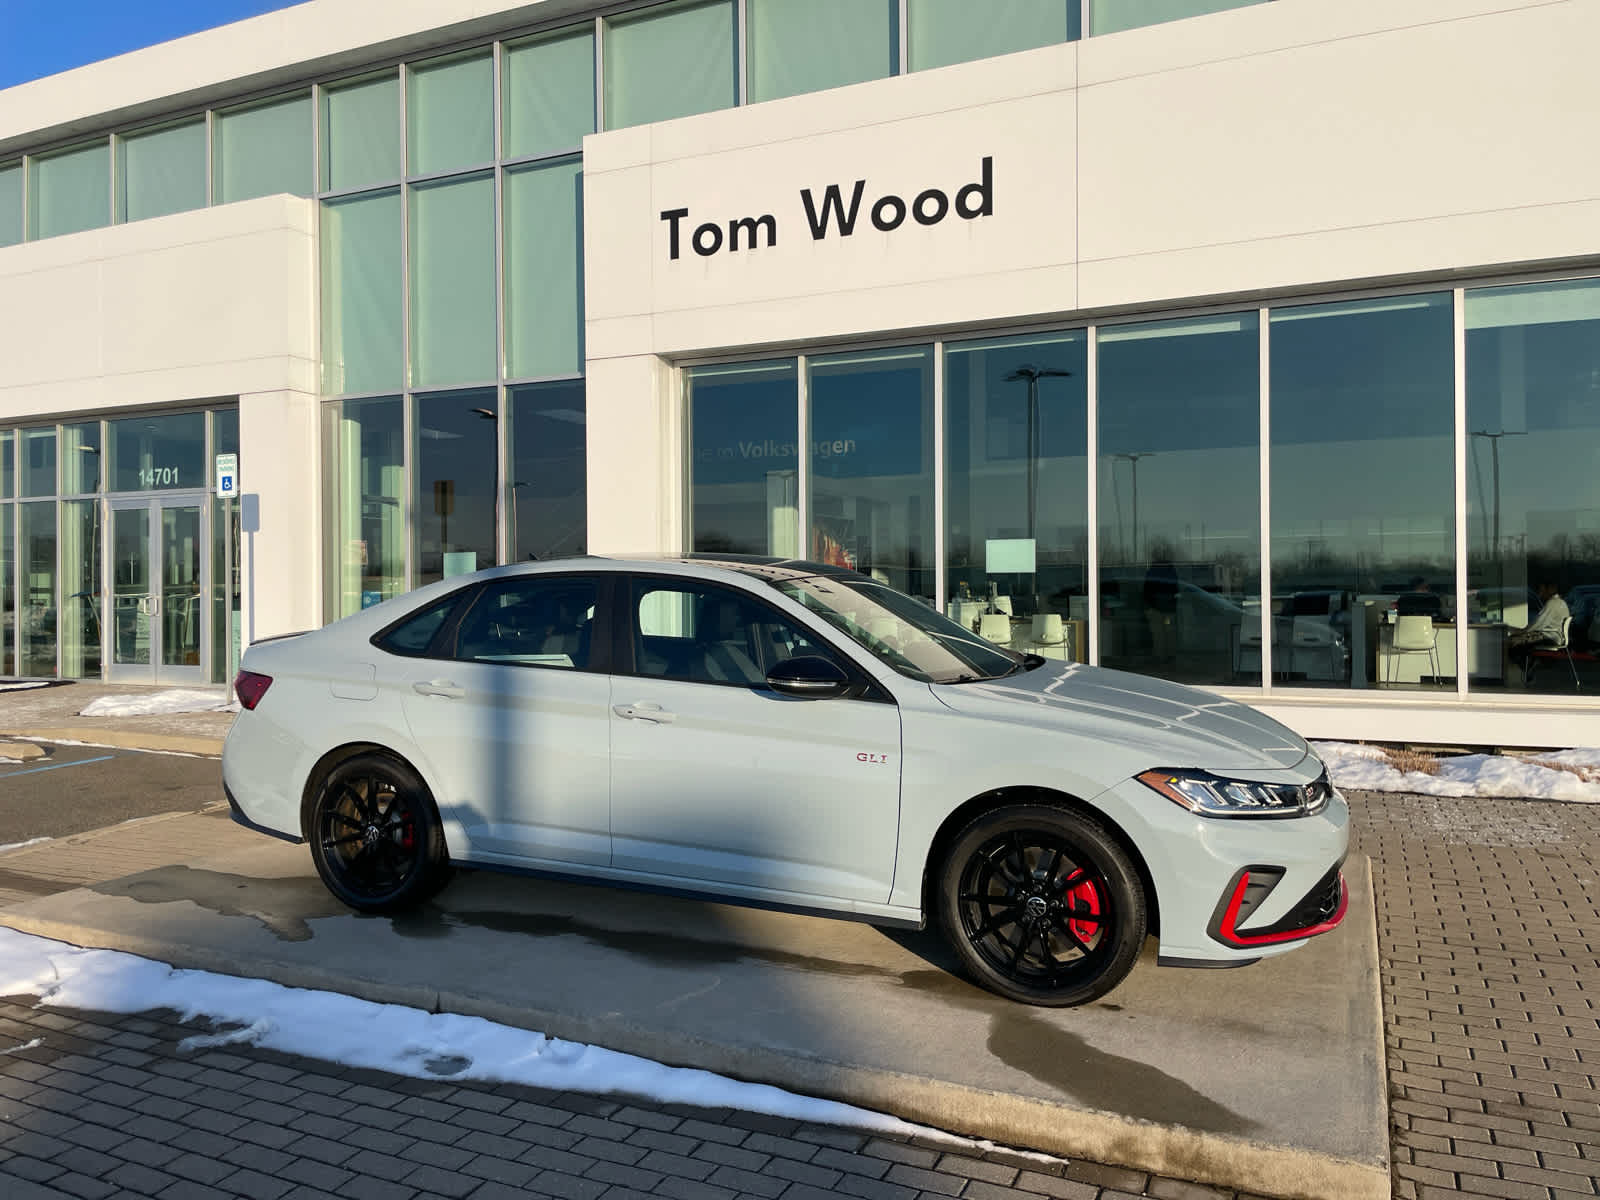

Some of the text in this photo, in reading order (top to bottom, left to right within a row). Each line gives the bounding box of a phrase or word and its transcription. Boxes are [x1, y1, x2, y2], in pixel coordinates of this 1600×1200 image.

[660, 156, 994, 260] Tom Wood
[138, 467, 179, 486] 14701
[856, 752, 888, 764] GLI
